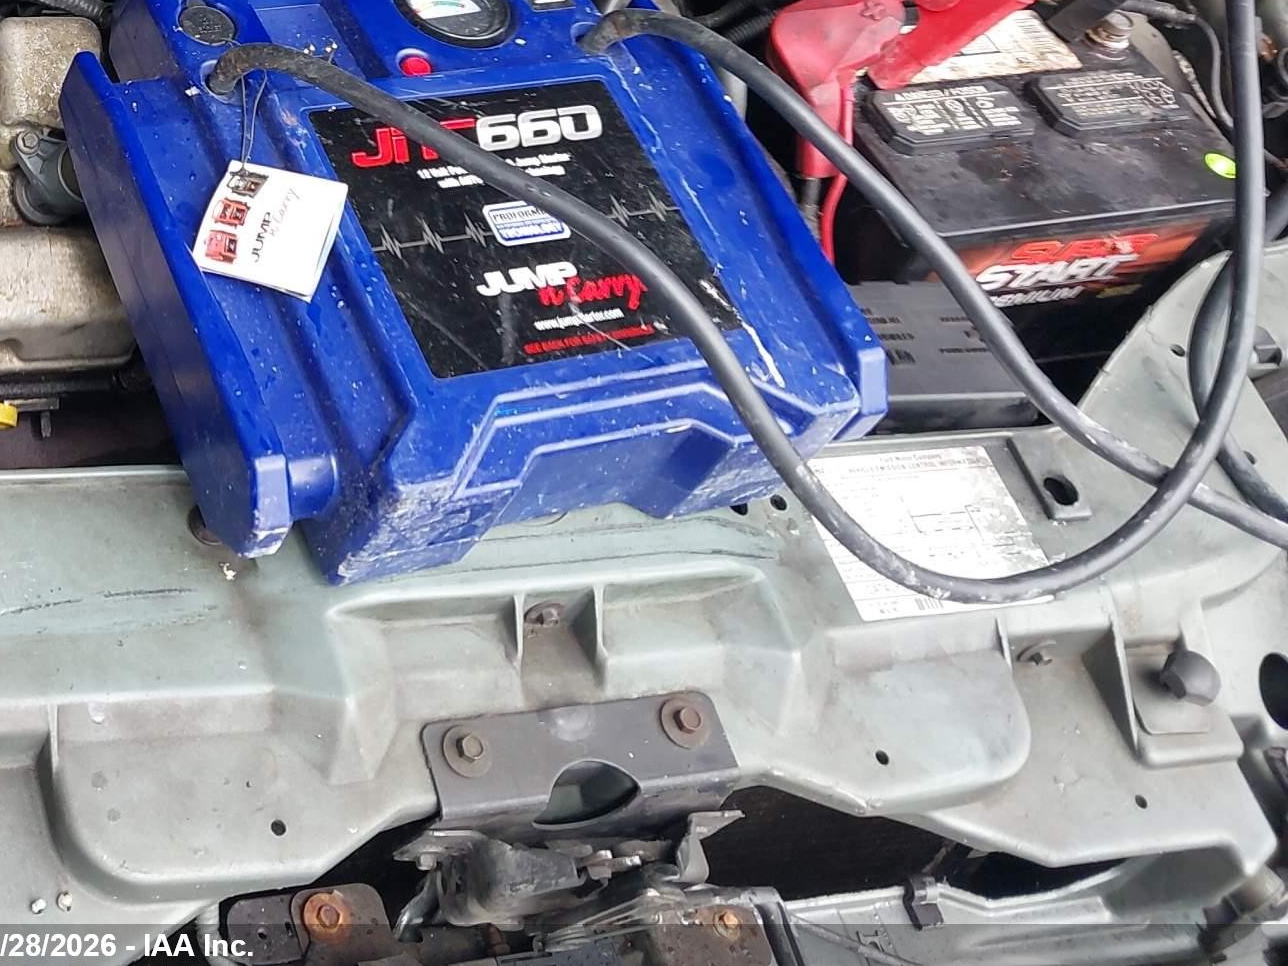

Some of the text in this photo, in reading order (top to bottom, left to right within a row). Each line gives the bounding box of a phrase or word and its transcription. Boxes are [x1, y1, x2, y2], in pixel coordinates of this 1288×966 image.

[351, 104, 603, 168] J660
[251, 212, 271, 263] JUMP
[477, 262, 577, 296] JUMP
[976, 254, 1139, 290] START
[565, 274, 648, 310] Carry
[991, 285, 1085, 308] EMIUM
